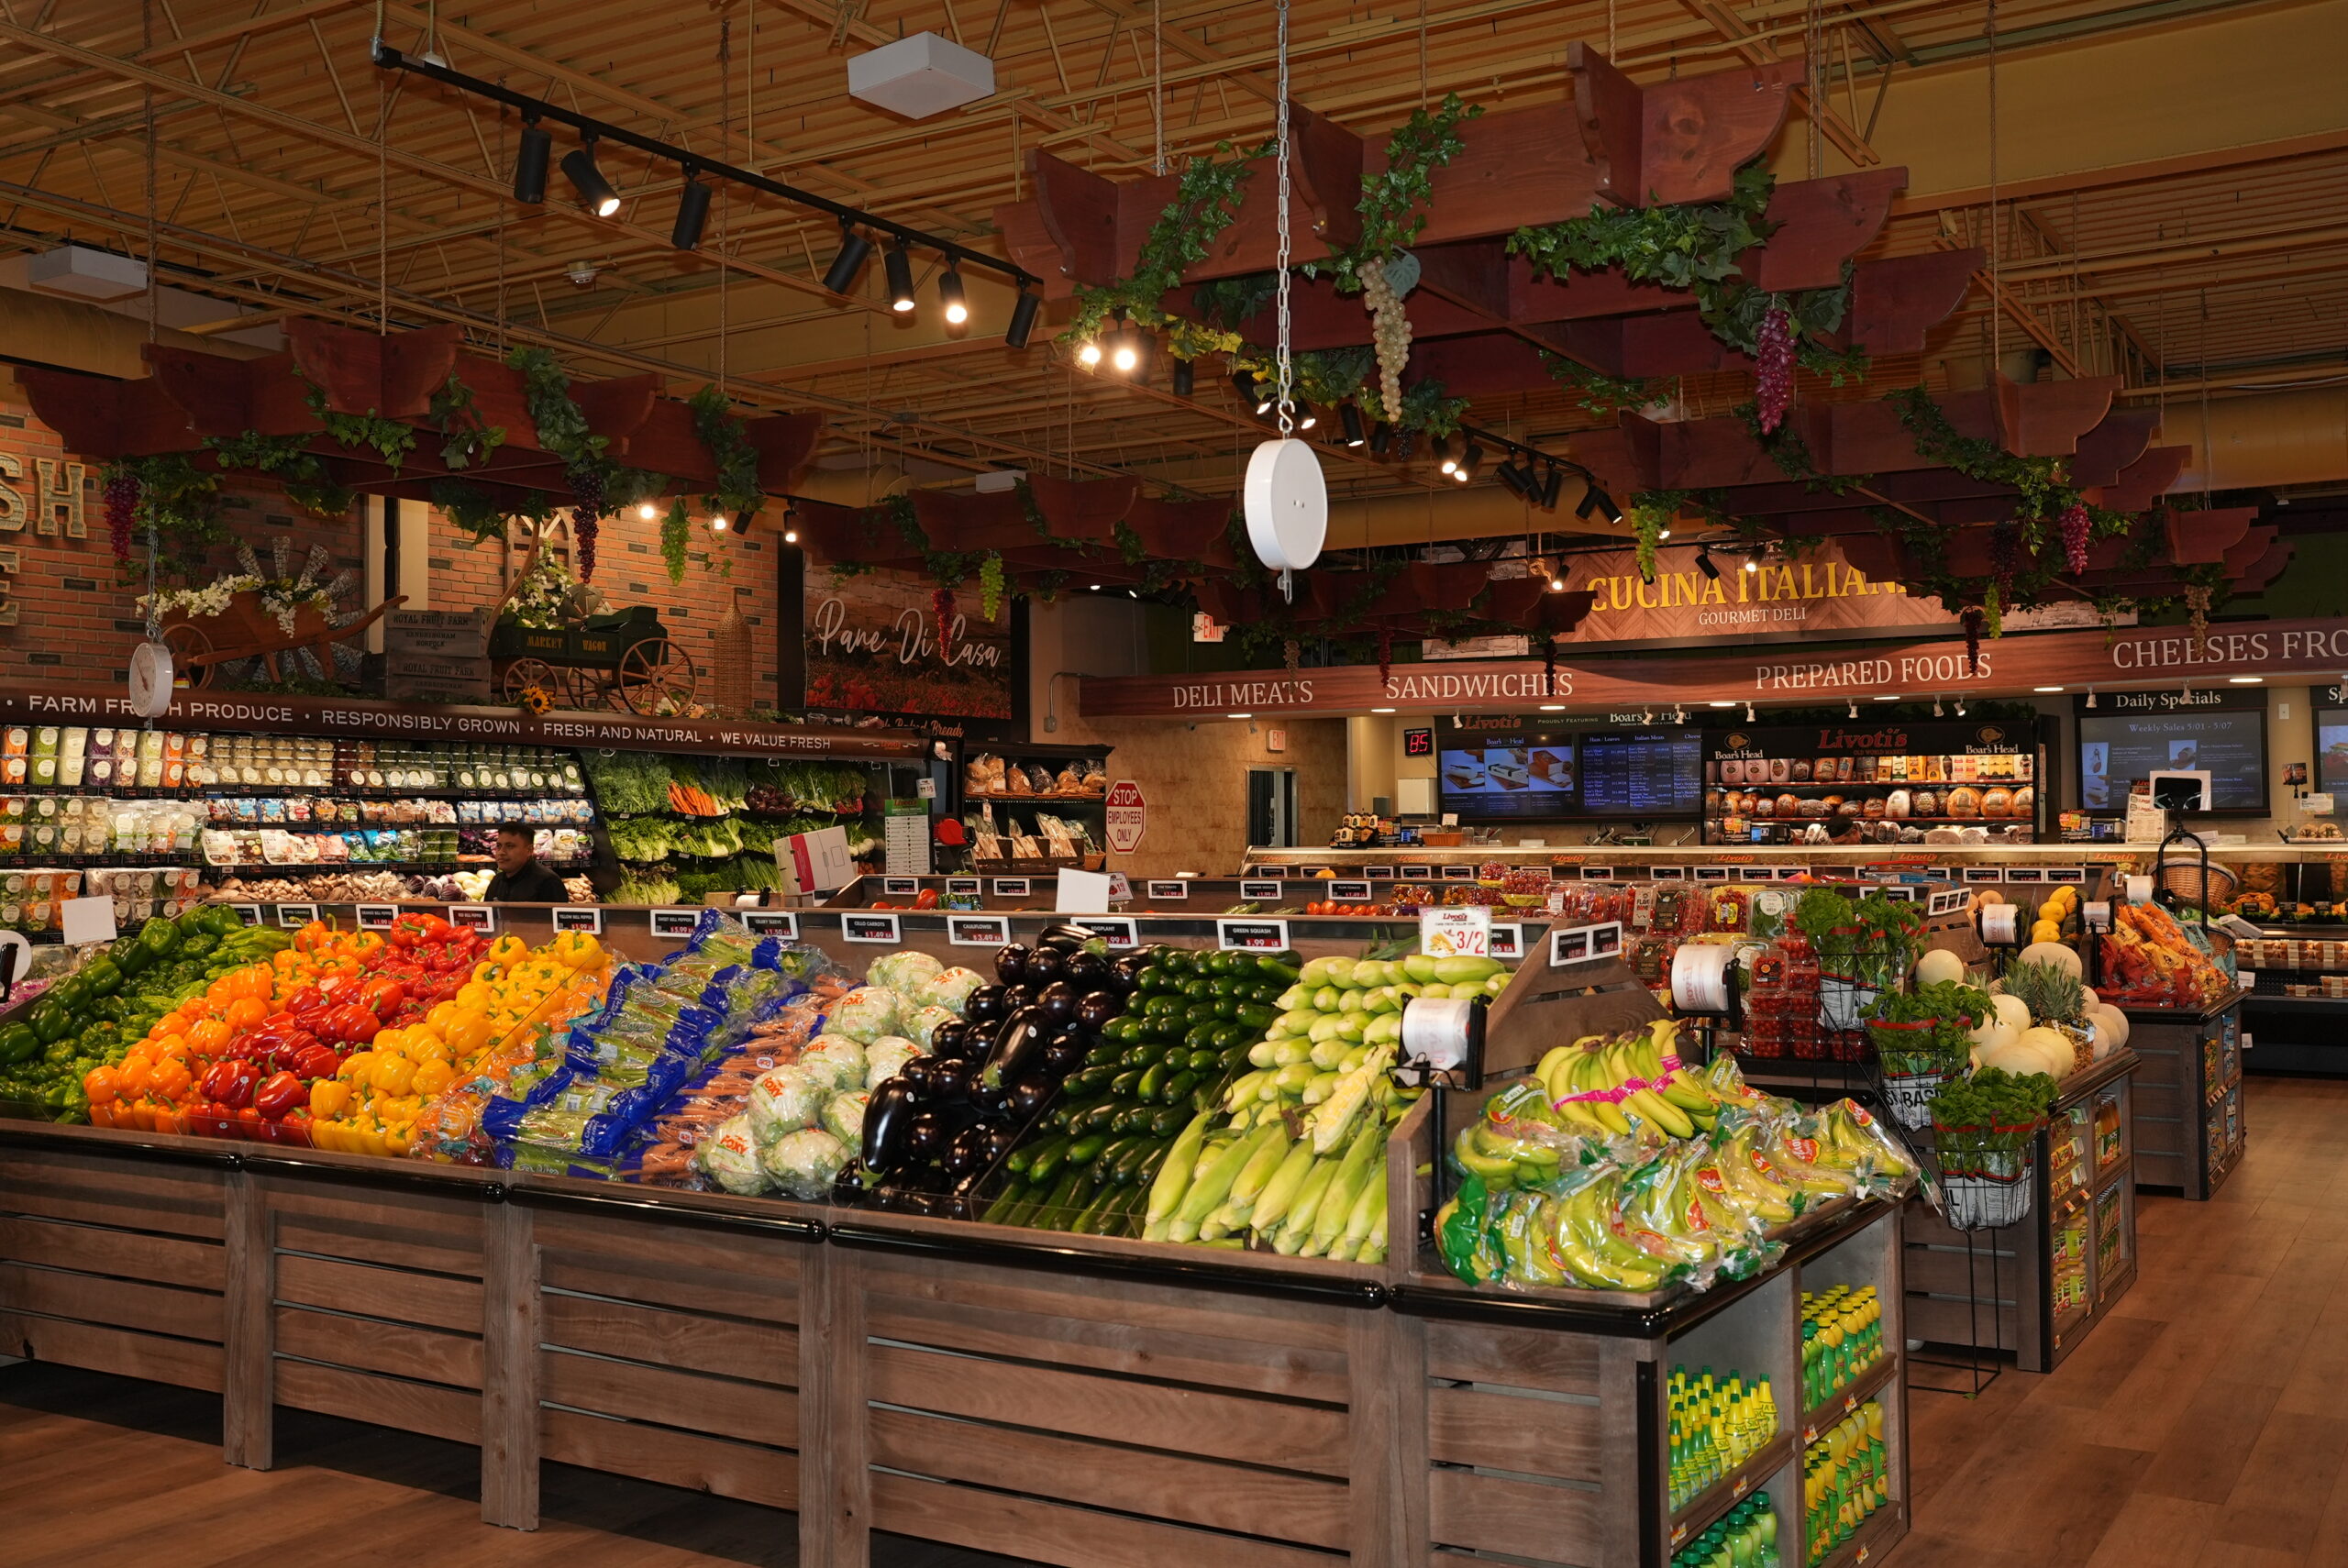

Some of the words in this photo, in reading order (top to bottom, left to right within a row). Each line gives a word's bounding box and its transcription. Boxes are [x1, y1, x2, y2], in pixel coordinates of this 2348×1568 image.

[1588, 571, 1728, 612] CUCINA
[1736, 561, 1907, 603] ITALIA
[393, 616, 419, 624] ROYAL
[421, 615, 446, 625] FRUIT
[448, 616, 470, 626] FARM
[1699, 609, 1768, 626] GOURMET
[1773, 607, 1807, 623] DELI
[814, 598, 888, 657] Pane
[895, 608, 934, 665] Di
[946, 613, 1001, 668] Casa
[526, 635, 563, 650] MARKET
[581, 639, 607, 652] WAGON
[2112, 633, 2270, 668] CHEESES
[403, 663, 427, 673] ROYAL
[429, 665, 453, 675] FRUIT
[455, 666, 475, 677] FARM
[1755, 659, 1893, 690] PREPARED
[1900, 652, 1992, 683] FOODS
[1172, 684, 1224, 709] DELI
[1230, 680, 1313, 706] MEATS
[2115, 693, 2156, 711] Daily
[28, 694, 97, 714] FARM
[105, 698, 183, 718] FRH
[190, 701, 294, 723] PRODUCE
[321, 709, 453, 731] RESPONSIBLY
[458, 717, 521, 734] GROWN
[2128, 723, 2161, 734] Weekly
[2163, 723, 2185, 733] Sales
[2187, 723, 2206, 733] 5/01
[543, 722, 596, 739] FRESH
[599, 725, 633, 740] AND
[636, 725, 703, 744] NATURAL
[720, 732, 741, 745] WE
[744, 733, 786, 747] VALUE
[789, 735, 831, 750] FRESH
[1409, 734, 1429, 753] 85
[1966, 744, 1992, 755] Boar's
[1993, 743, 2019, 754] Head
[1714, 750, 1739, 760] Boar's
[1740, 749, 1764, 759] Head
[1113, 789, 1138, 805] STOP
[1107, 811, 1142, 824] EMPLOYEES
[1116, 828, 1133, 843] ONLY
[670, 925, 688, 933] $5.99
[765, 928, 783, 936] $1.50
[972, 933, 993, 942] $3.49
[1250, 927, 1272, 935] SQUASH
[1456, 930, 1485, 955] 3/2
[762, 1076, 785, 1099] FOXY
[719, 1134, 750, 1156] FOXY
